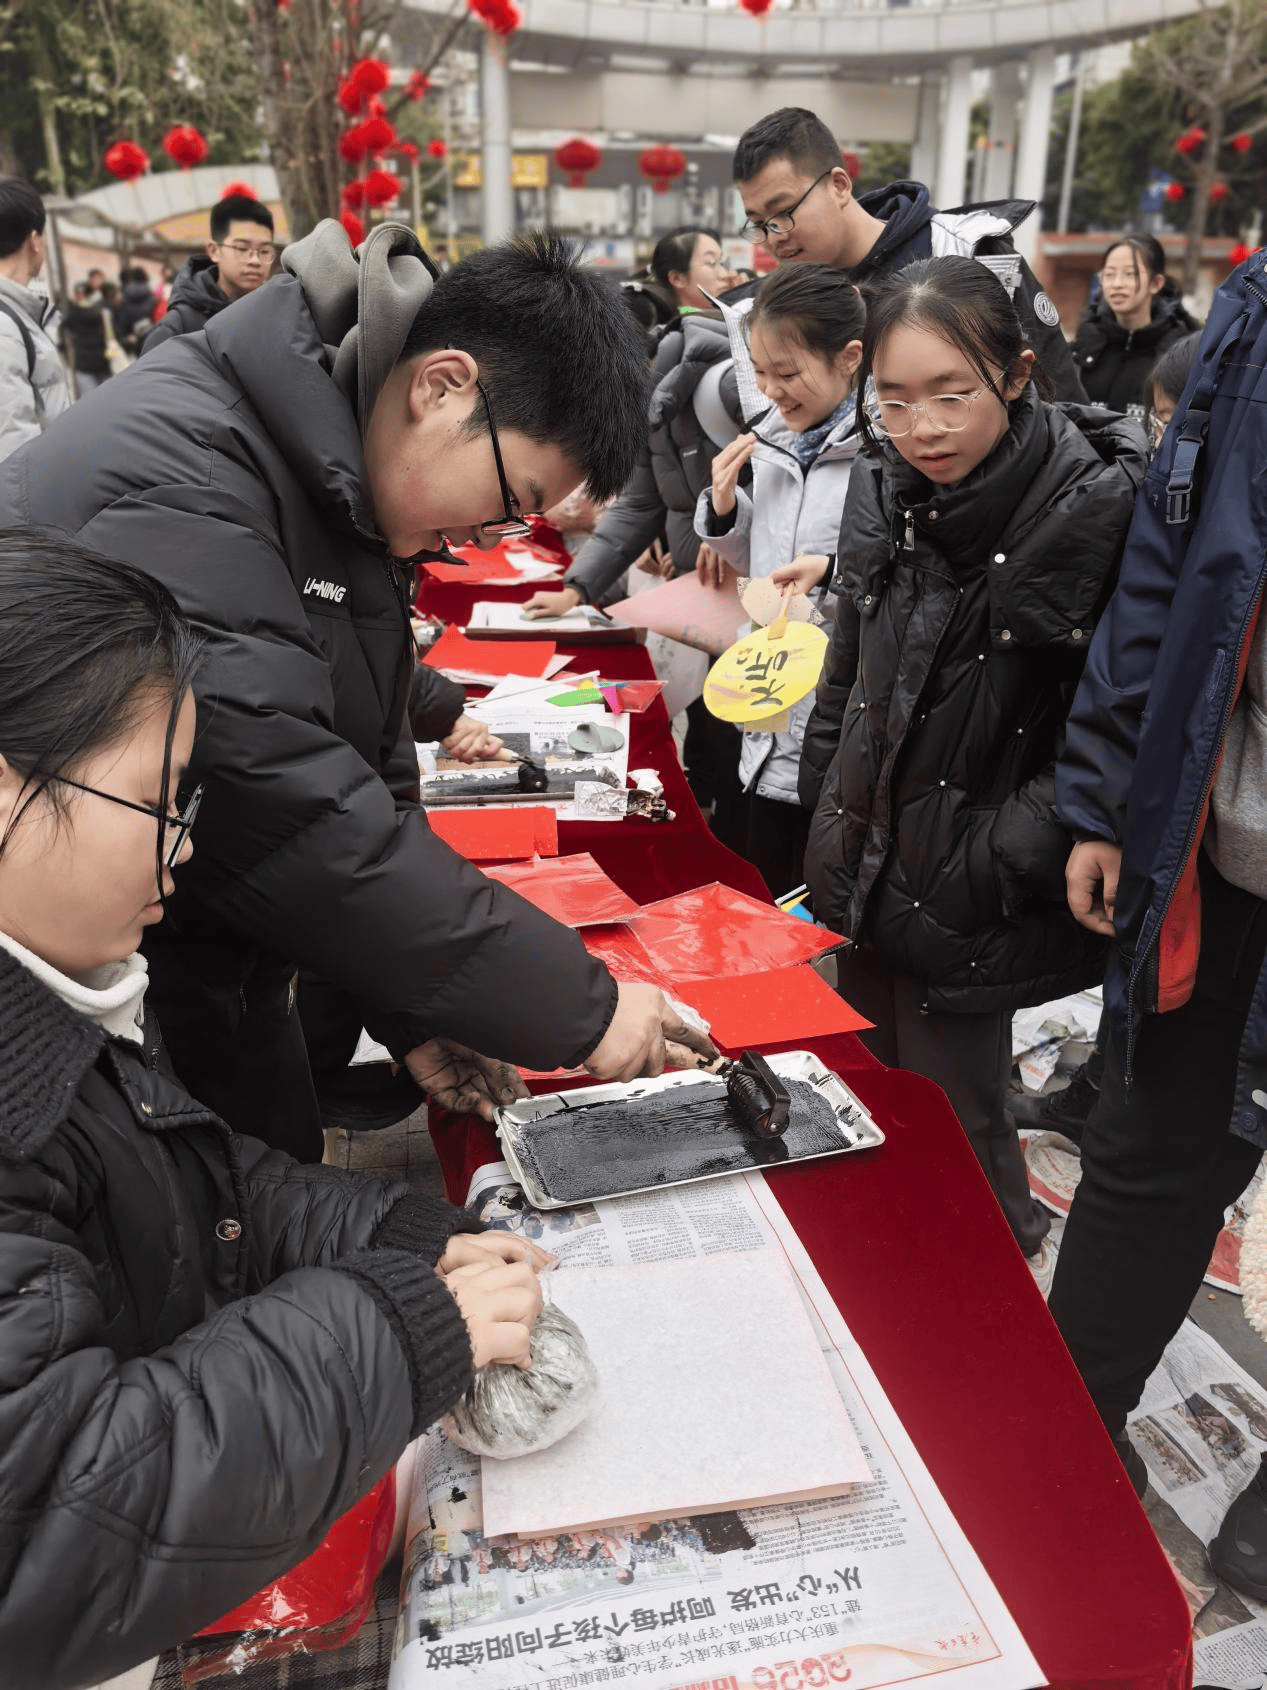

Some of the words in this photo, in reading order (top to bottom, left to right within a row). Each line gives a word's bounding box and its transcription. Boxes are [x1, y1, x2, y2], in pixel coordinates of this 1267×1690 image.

[303, 577, 347, 603] LI-NING
[425, 1597, 717, 1671] 呵护每个孩子向阳绽放
